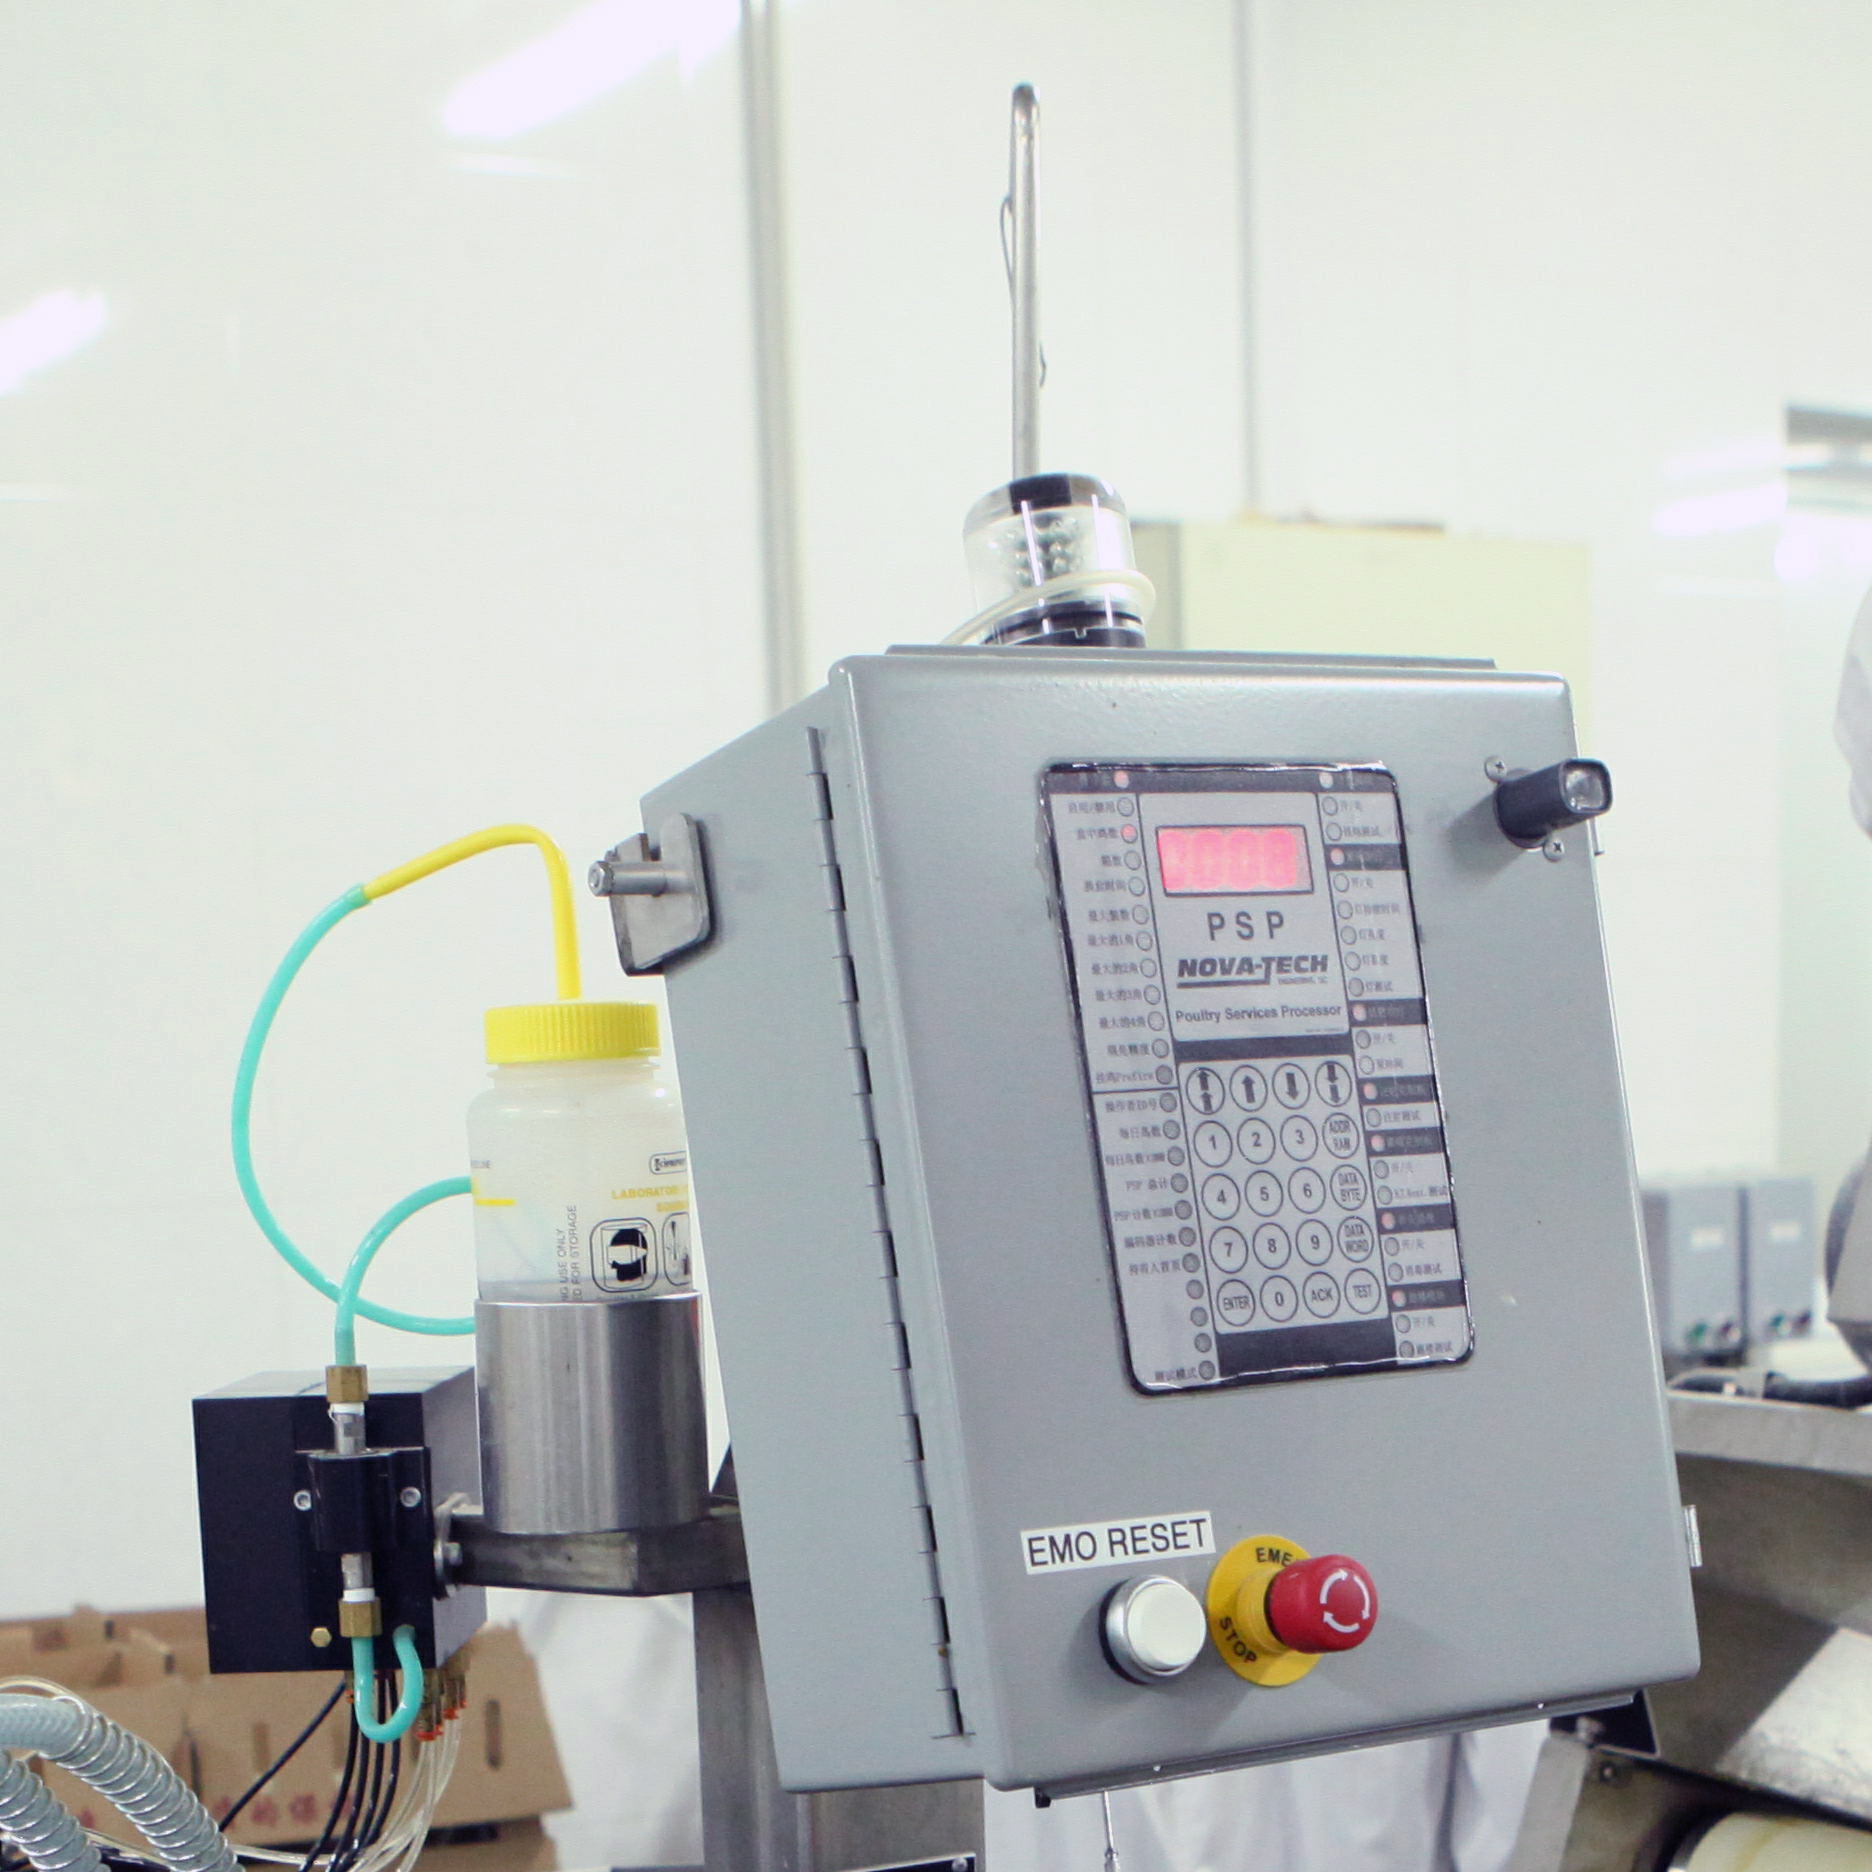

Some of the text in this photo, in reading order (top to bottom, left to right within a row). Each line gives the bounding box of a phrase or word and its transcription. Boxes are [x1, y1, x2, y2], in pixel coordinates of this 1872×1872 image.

[1177, 954, 1329, 985] NOVA-TECH
[1175, 1005, 1342, 1023] Poultry Services Processor
[1208, 1135, 1217, 1150] 1
[1251, 1132, 1261, 1147] 2
[1295, 1129, 1305, 1144] 3
[1338, 1173, 1358, 1186] DATA
[1217, 1189, 1226, 1203] 4
[1259, 1187, 1270, 1201] 5
[1302, 1183, 1313, 1198] 6
[566, 1204, 580, 1258] STORAGE
[1344, 1224, 1365, 1237] DATA
[555, 1228, 567, 1258] ONLY
[1224, 1243, 1233, 1257] 7
[1267, 1239, 1277, 1253] 8
[1310, 1235, 1320, 1250] 9
[1311, 1287, 1333, 1302] ACK
[1351, 1284, 1372, 1298] TEST
[1223, 1295, 1251, 1311] ENTER
[1275, 1292, 1284, 1306] 0
[1027, 1518, 1209, 1567] EMO RESET
[1218, 1616, 1258, 1665] STOP
